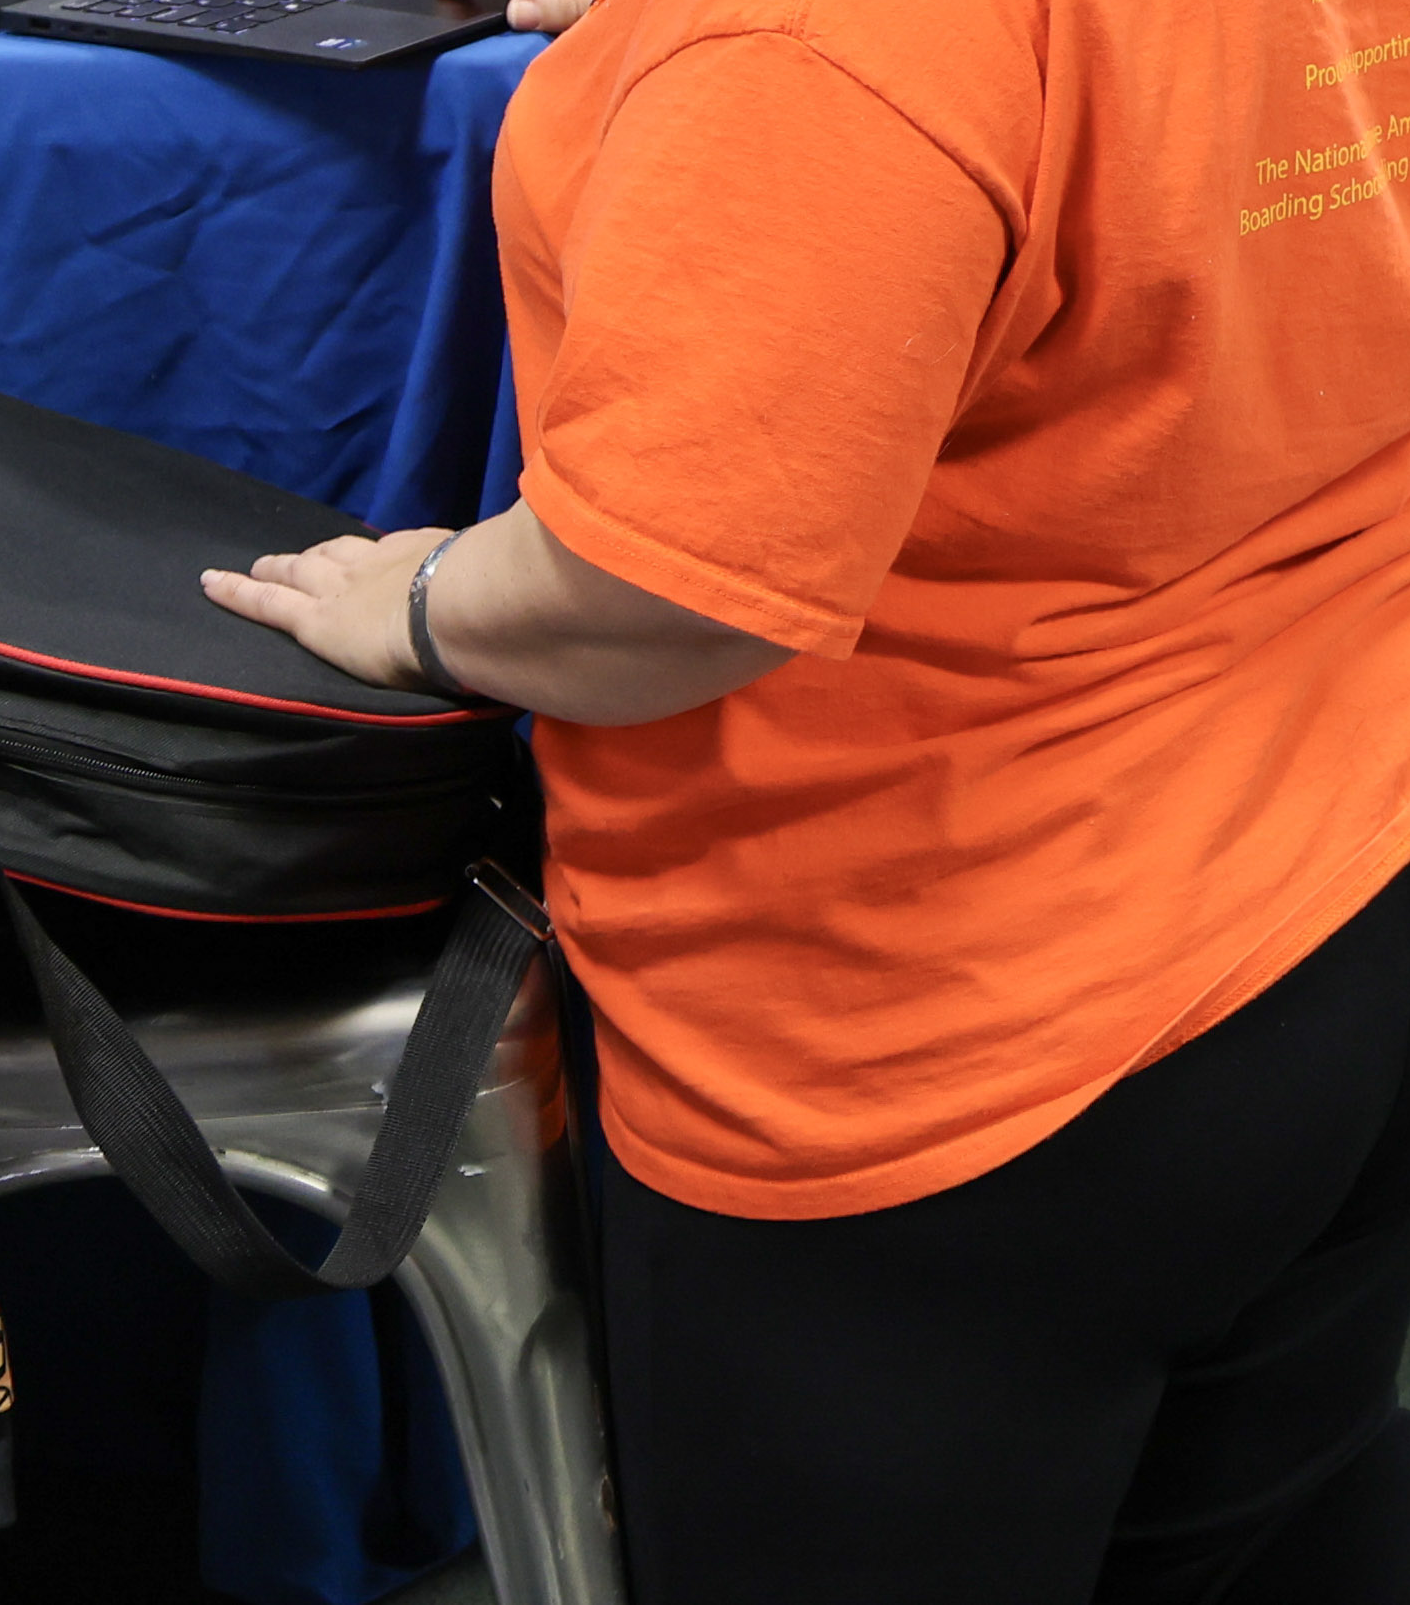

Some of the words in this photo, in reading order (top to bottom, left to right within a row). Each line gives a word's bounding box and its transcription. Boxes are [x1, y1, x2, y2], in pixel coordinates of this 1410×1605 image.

[1255, 156, 1289, 186] The
[1295, 139, 1369, 176] Nationa
[1239, 192, 1324, 237] Boarding
[1329, 177, 1383, 210] Schoo
